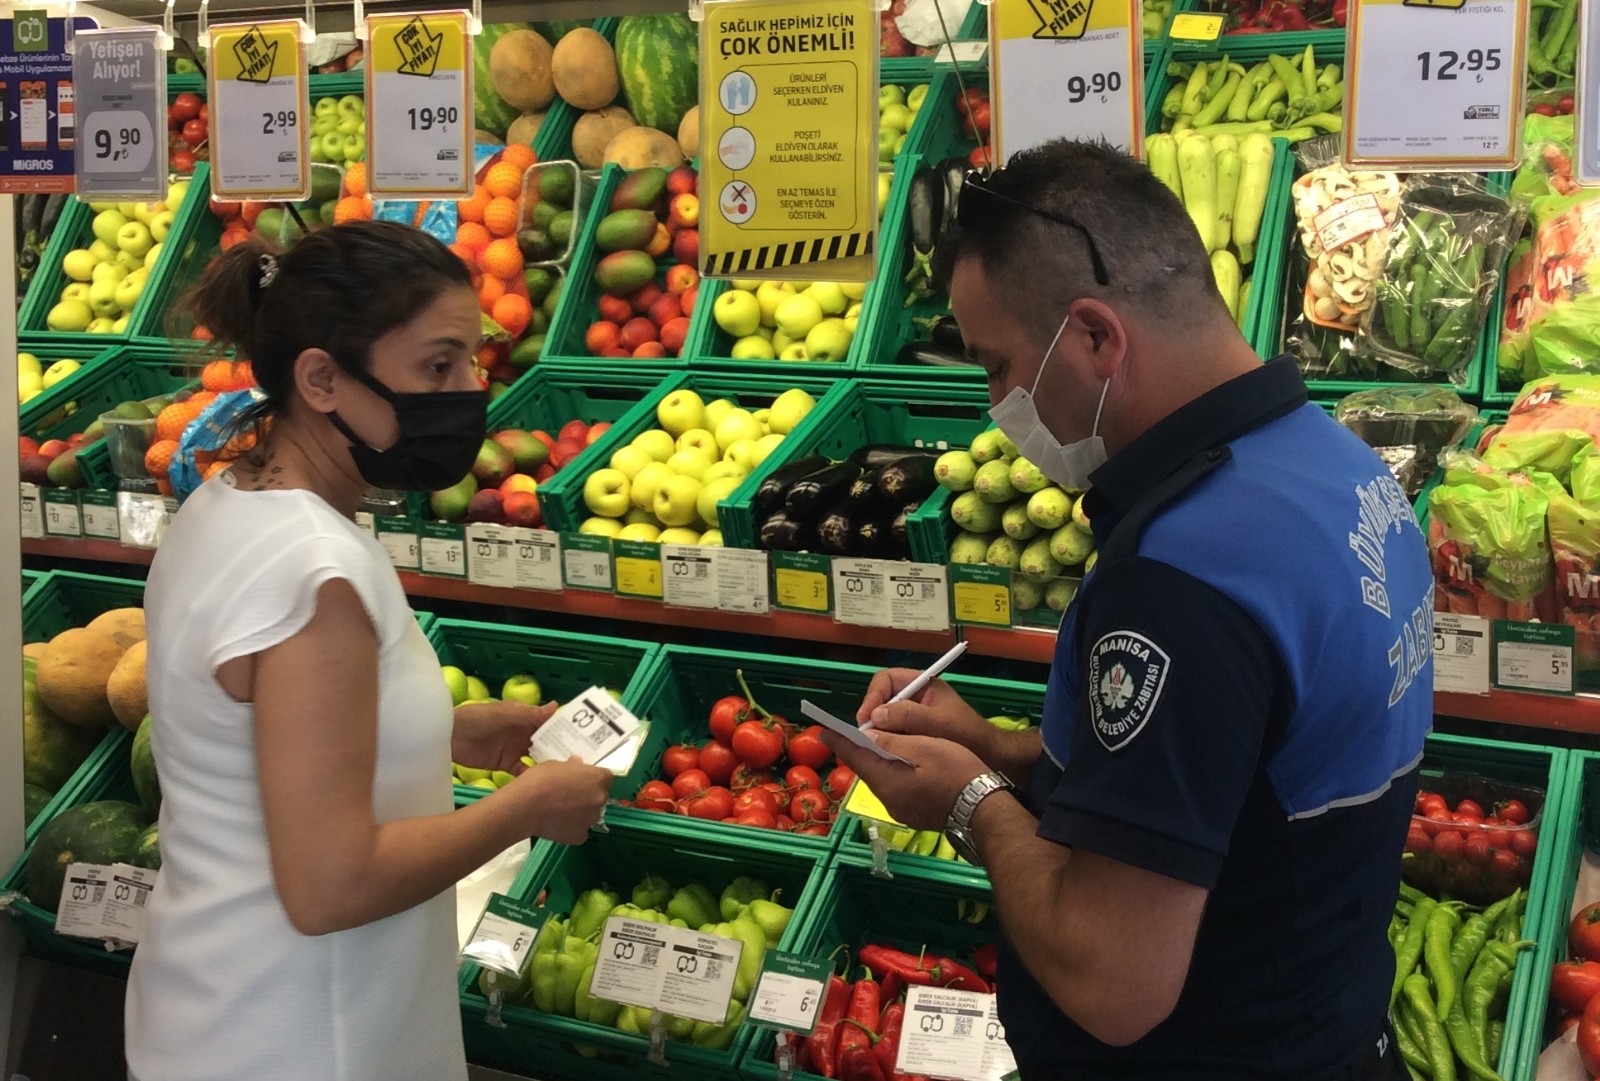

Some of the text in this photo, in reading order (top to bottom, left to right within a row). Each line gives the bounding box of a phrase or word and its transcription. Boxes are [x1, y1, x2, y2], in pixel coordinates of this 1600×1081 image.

[720, 14, 854, 33] SAĞLIK HEPİMİZ İÇİN
[720, 29, 854, 60] ÇOK ÖNEMLİ!
[89, 41, 144, 62] Yetişen
[93, 60, 141, 82] Alıyor!
[790, 72, 827, 83] ÜRÜNLERİ
[773, 84, 843, 96] SEÇERKEN ELDİVEN
[794, 130, 820, 141] POŞETİ
[776, 142, 838, 151] ELDİVEN OLARAK
[770, 153, 843, 163] KULLANABİLİRSİNİZ.
[777, 187, 837, 197] EN AZ TEMAS İLE
[780, 198, 835, 210] SEÇMEYE ÖZEN
[788, 210, 827, 220] GÖSTERİN.
[1100, 638, 1150, 662] MANİSA
[1134, 663, 1160, 711] ZABITASI
[1098, 709, 1140, 735] BELEDİYE
